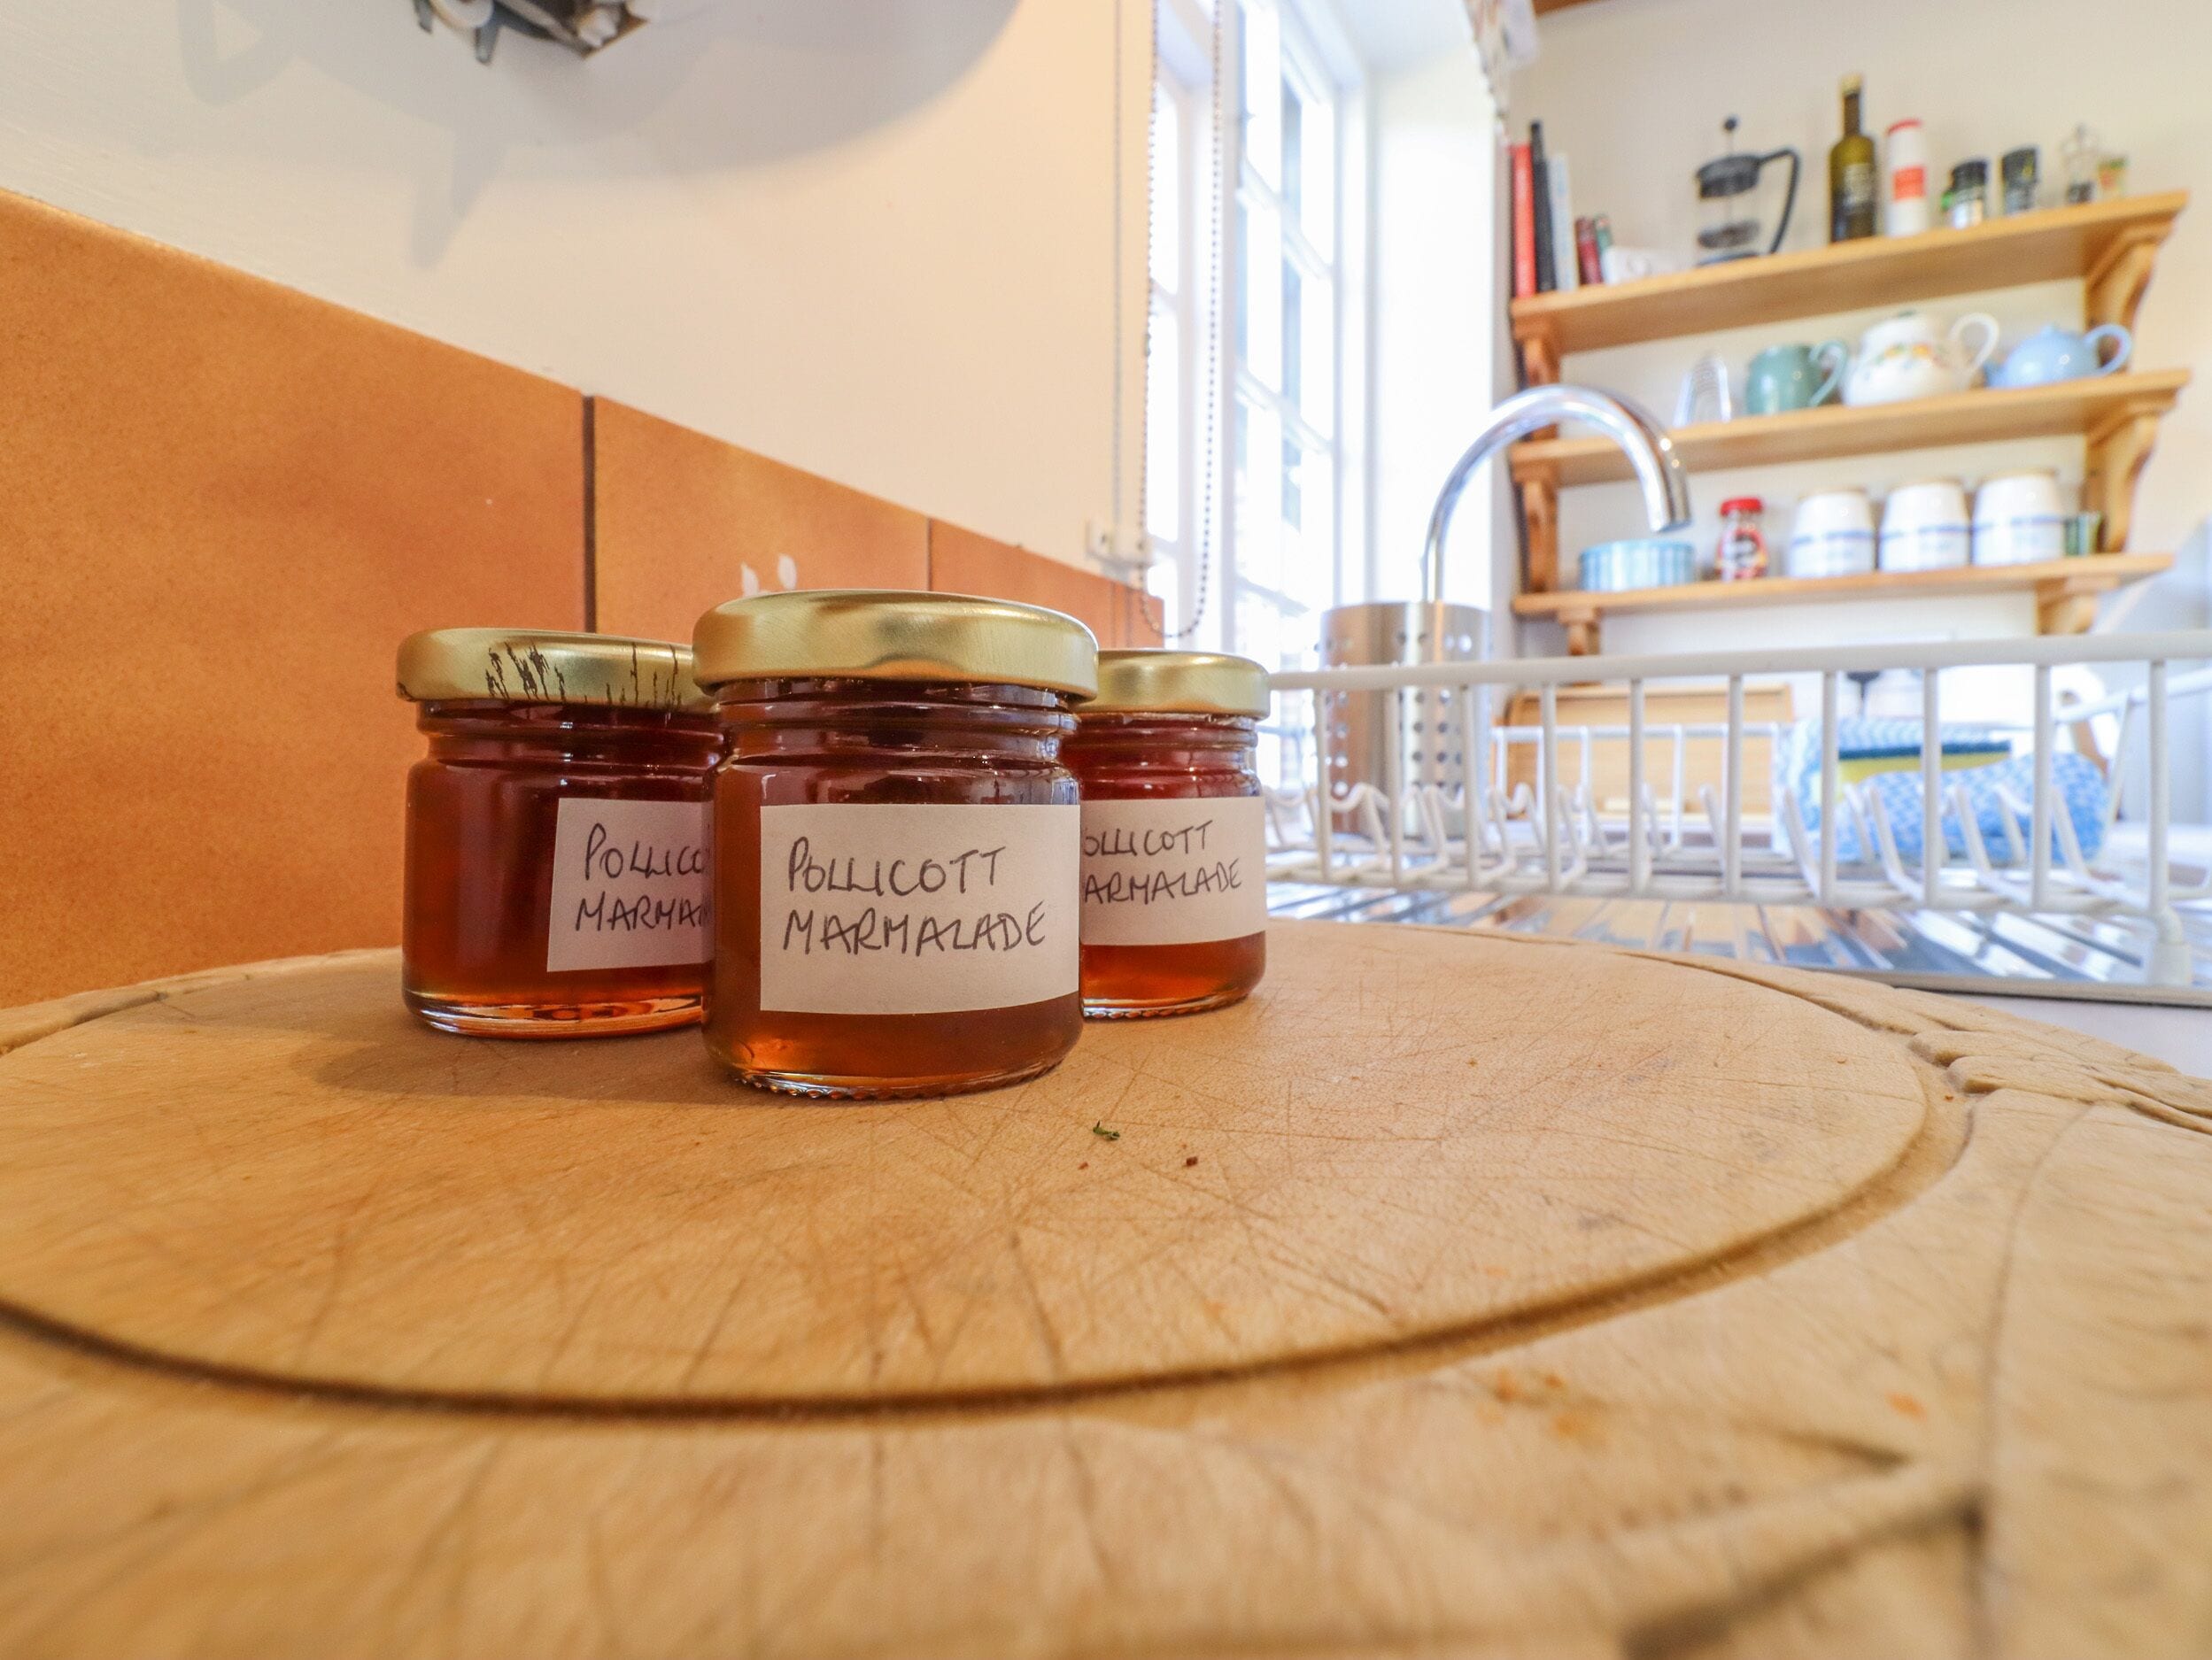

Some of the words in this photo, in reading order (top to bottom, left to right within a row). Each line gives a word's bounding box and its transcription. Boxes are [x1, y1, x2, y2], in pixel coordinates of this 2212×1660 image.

[788, 836, 1006, 896] POLLICOTT
[1084, 857, 1241, 905] ARMALADE
[783, 899, 1046, 956] MARMALADE
